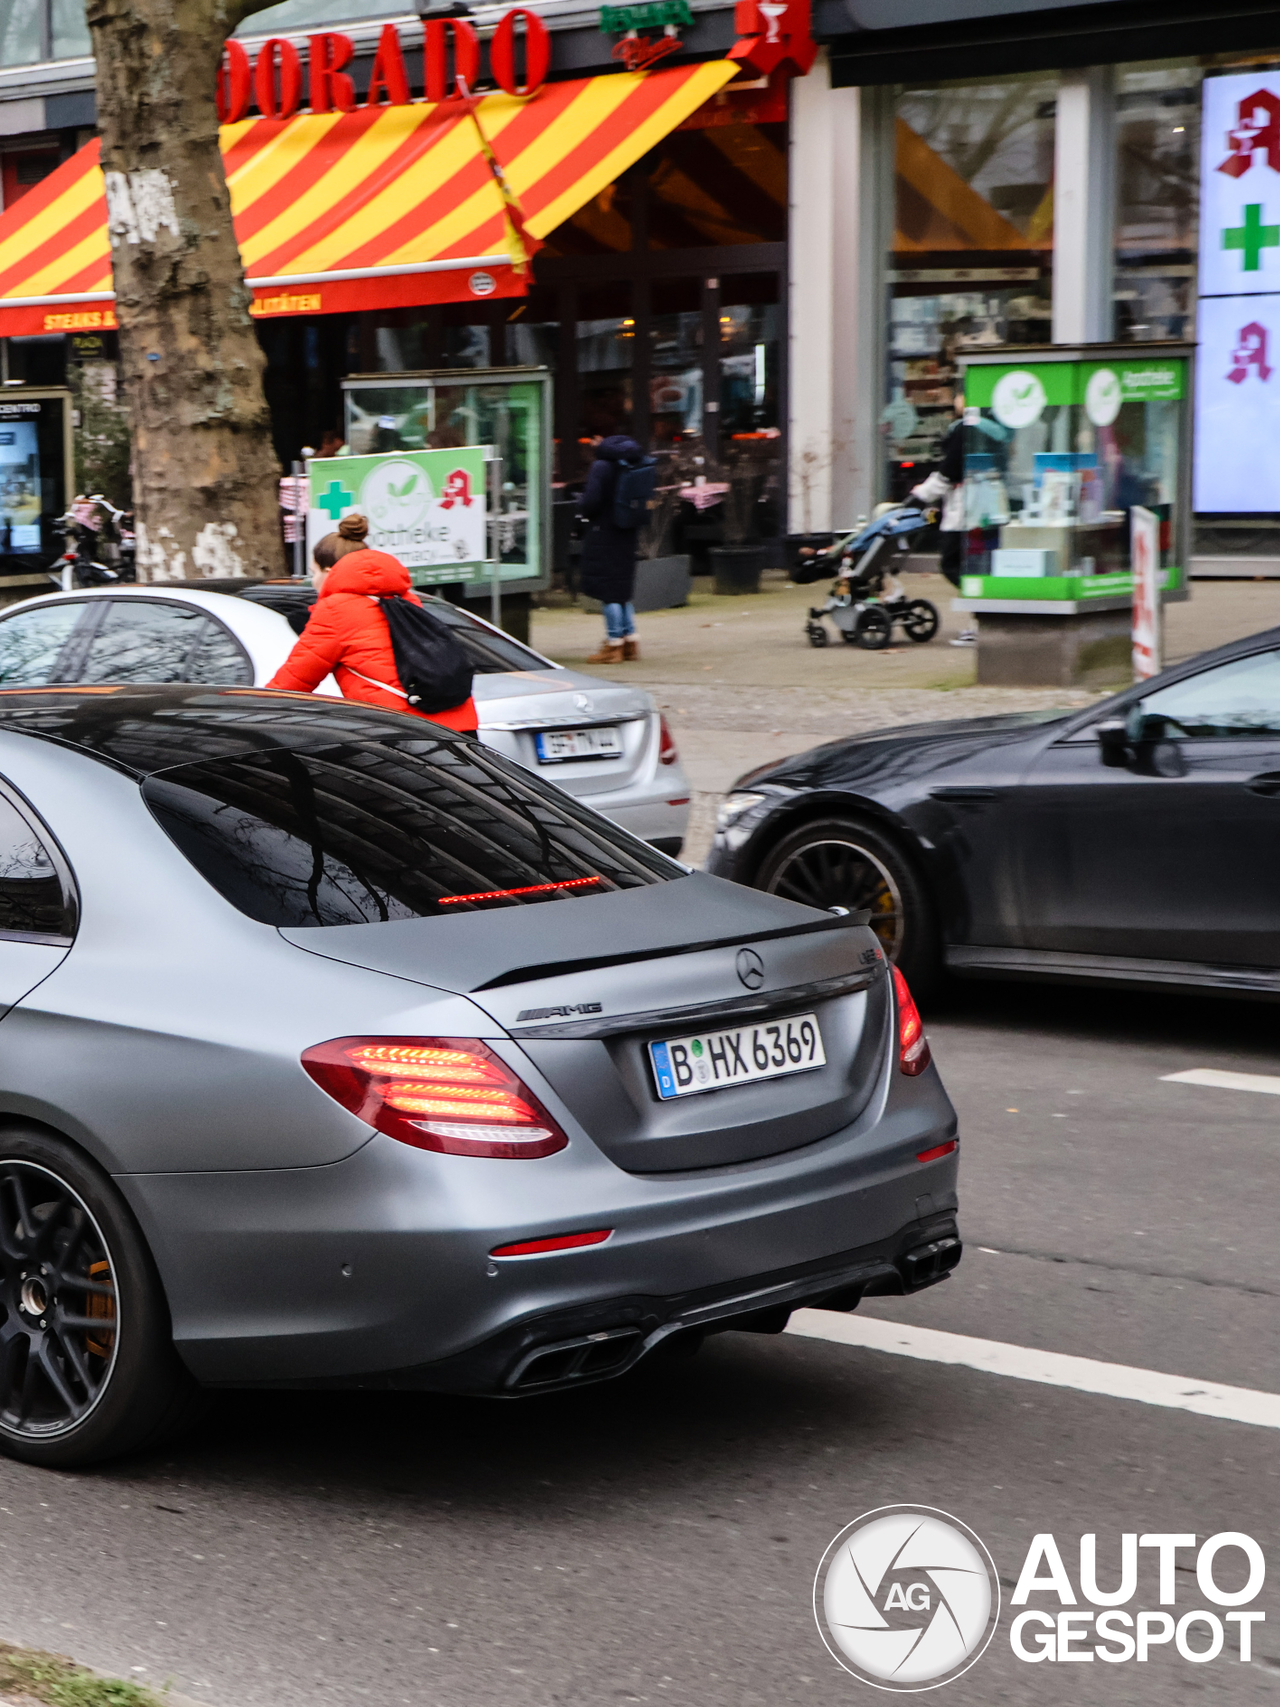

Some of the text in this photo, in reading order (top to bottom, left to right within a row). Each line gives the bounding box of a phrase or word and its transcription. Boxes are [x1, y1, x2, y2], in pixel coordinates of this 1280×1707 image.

[215, 9, 551, 124] DORADO
[43, 311, 102, 330] STEAKS
[542, 1002, 603, 1019] AMG
[671, 1044, 693, 1087] B
[707, 1032, 749, 1080] HX
[752, 1020, 817, 1071] 6369
